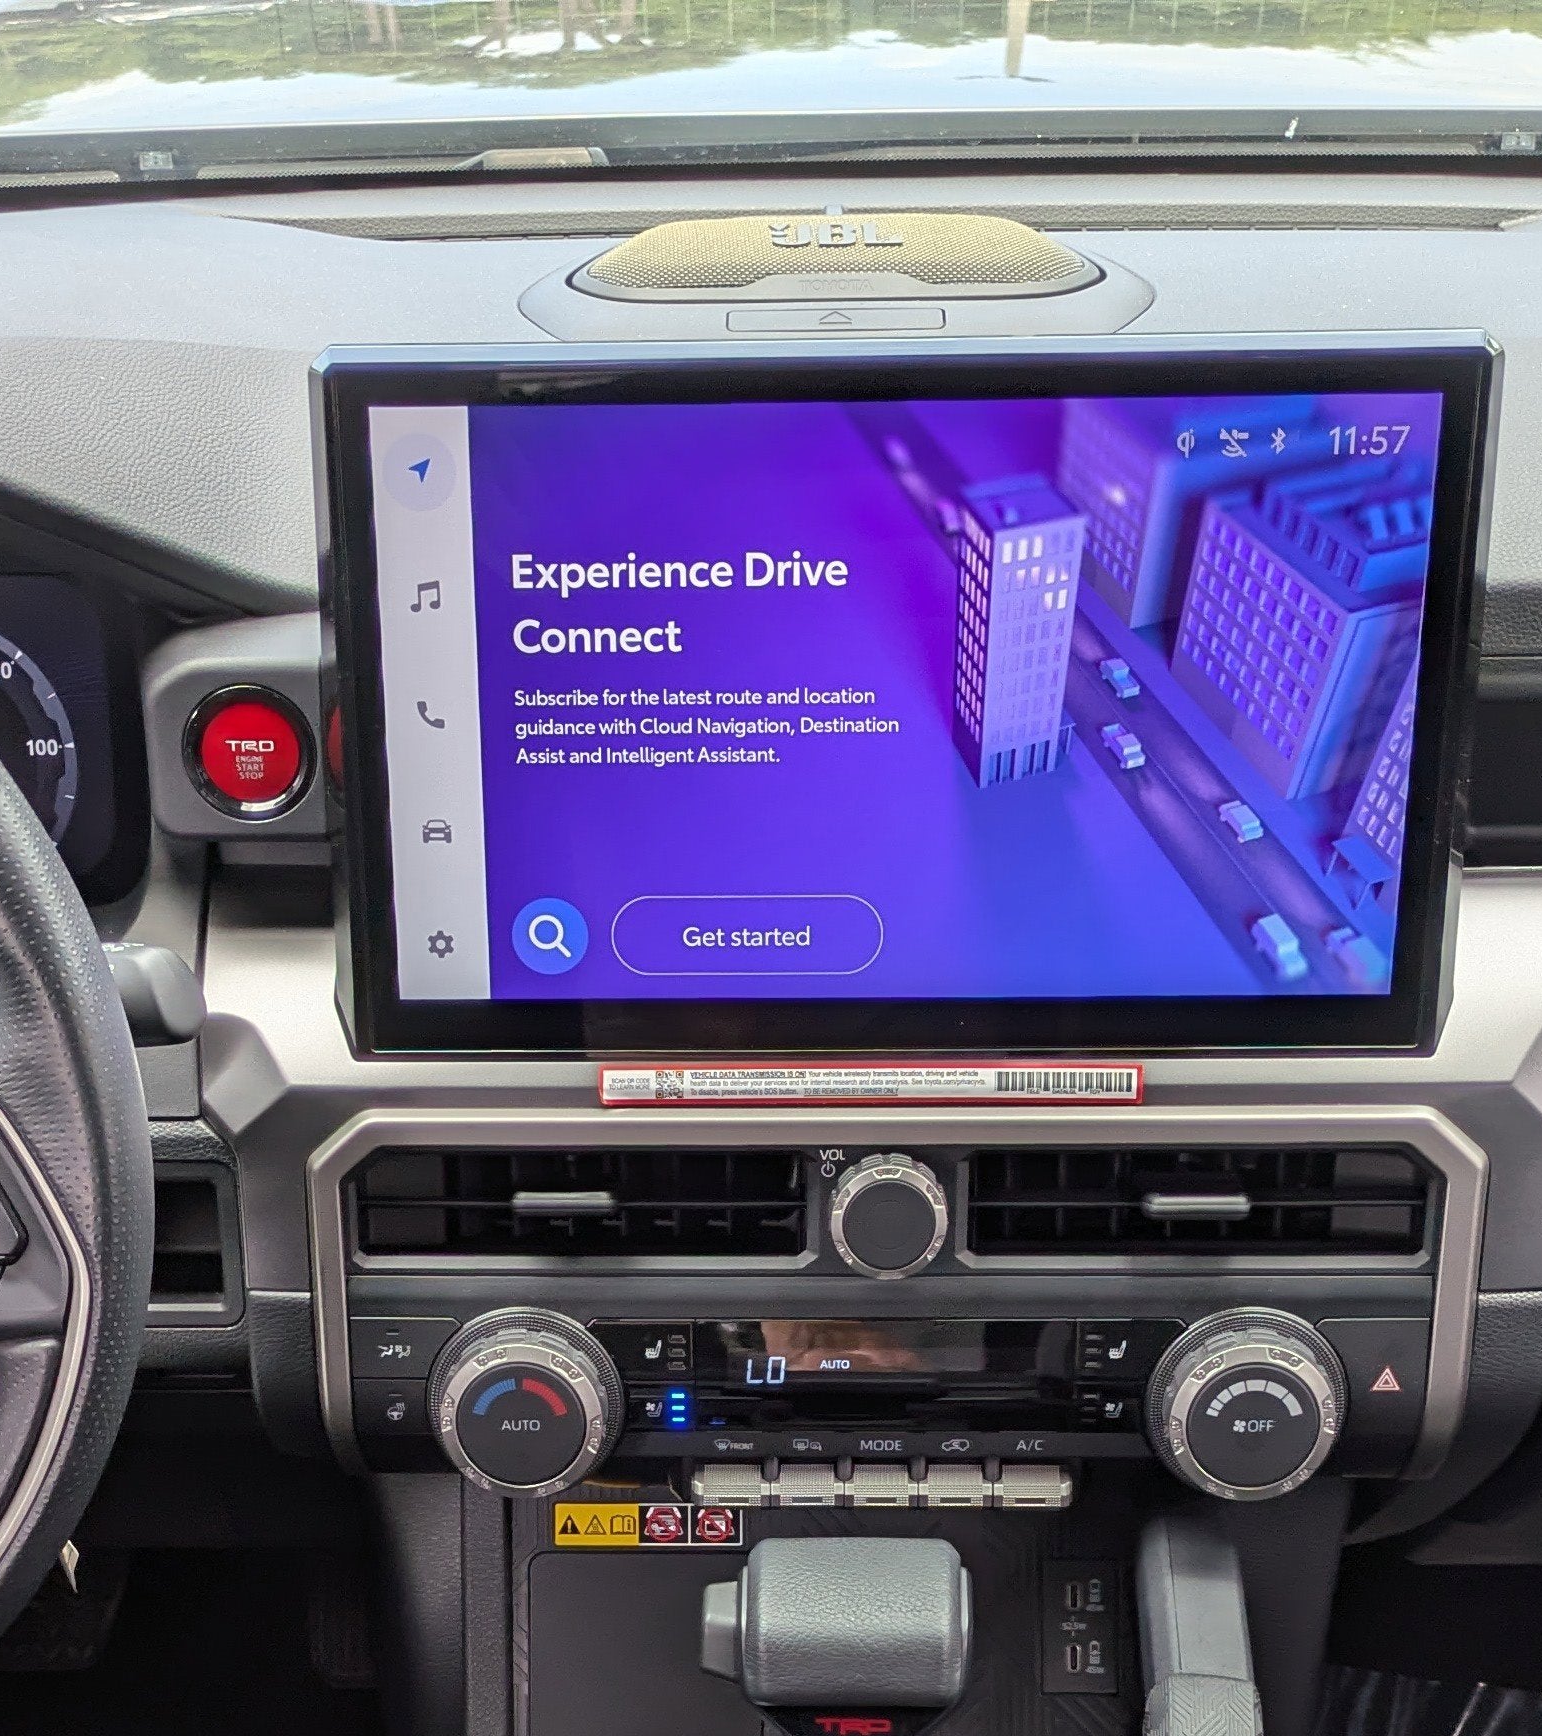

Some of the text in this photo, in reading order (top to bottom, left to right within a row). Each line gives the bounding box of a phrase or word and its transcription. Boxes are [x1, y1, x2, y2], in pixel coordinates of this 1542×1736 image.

[768, 223, 904, 247] JBL
[798, 278, 875, 293] TOYOTA
[1329, 425, 1411, 455] 11:57
[511, 550, 849, 599] Experience Drive
[513, 618, 683, 655] Connect
[514, 687, 876, 707] Subscribe for the latest route and location
[515, 715, 900, 739] guidance with Cloud Navigation, Destination
[26, 739, 59, 757] 100
[225, 740, 275, 753] TRD
[235, 755, 264, 763] ENGINE
[516, 746, 781, 767] Assist and Intelligent Assistant.
[236, 763, 265, 771] START
[239, 771, 264, 780] STOP
[682, 925, 811, 947] Get started
[819, 1149, 846, 1161] VOL
[819, 1359, 850, 1370] AUTO
[501, 1419, 541, 1432] AUTO
[1246, 1419, 1275, 1433] OFF
[730, 1442, 755, 1451] FRONT
[859, 1439, 902, 1452] MODE
[1015, 1438, 1044, 1452] A/C
[814, 1717, 892, 1736] TRD
